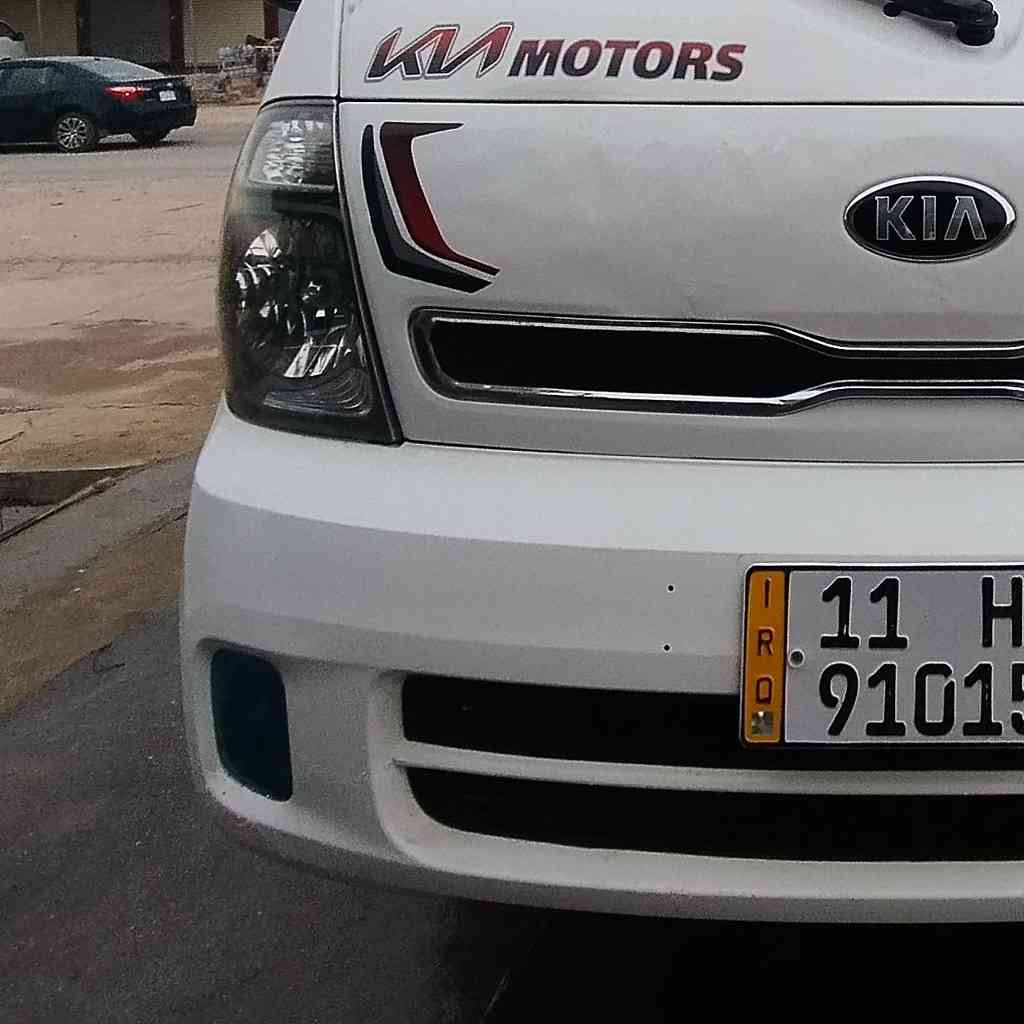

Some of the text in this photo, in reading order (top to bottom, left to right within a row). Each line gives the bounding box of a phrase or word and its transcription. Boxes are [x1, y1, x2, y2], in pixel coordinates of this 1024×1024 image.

[506, 38, 747, 81] MOTORS
[875, 195, 987, 241] KIA
[820, 576, 909, 649] 11
[981, 576, 1024, 649] H
